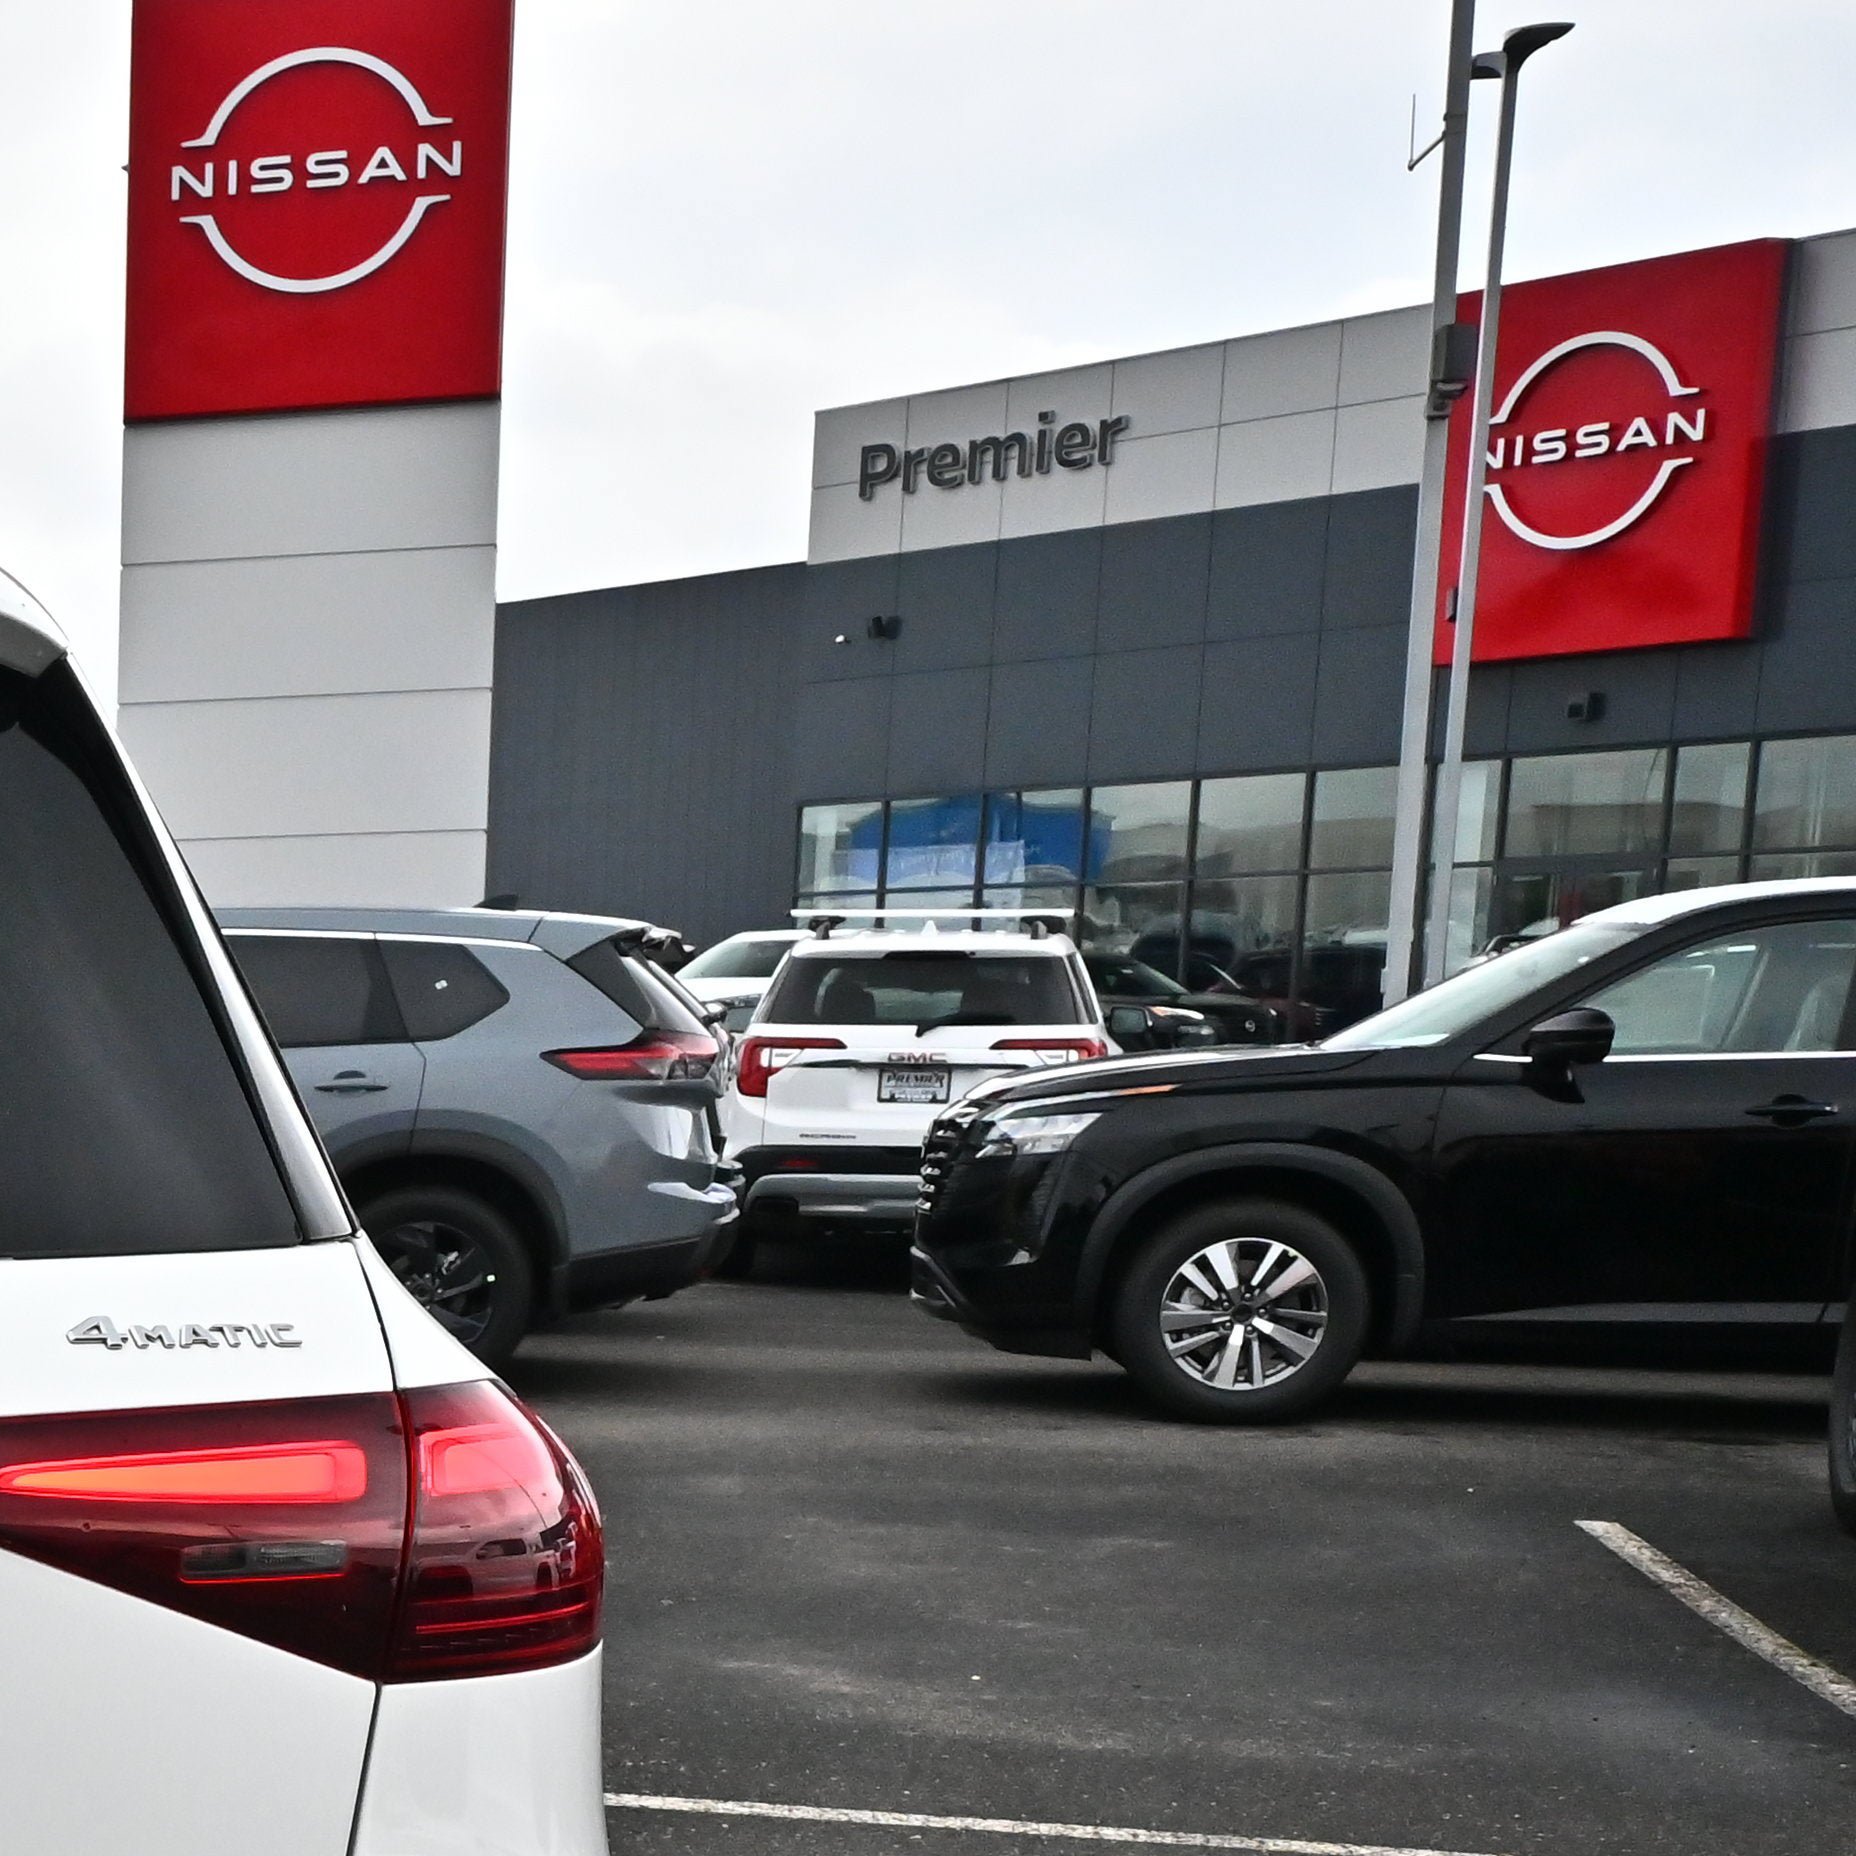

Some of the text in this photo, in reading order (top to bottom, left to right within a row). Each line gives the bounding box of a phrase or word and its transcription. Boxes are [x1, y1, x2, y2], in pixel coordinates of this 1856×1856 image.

[171, 140, 462, 201] NISSAN
[859, 410, 1130, 500] Premier
[887, 1052, 948, 1064] GMC
[66, 1315, 303, 1350] 4MATIC
